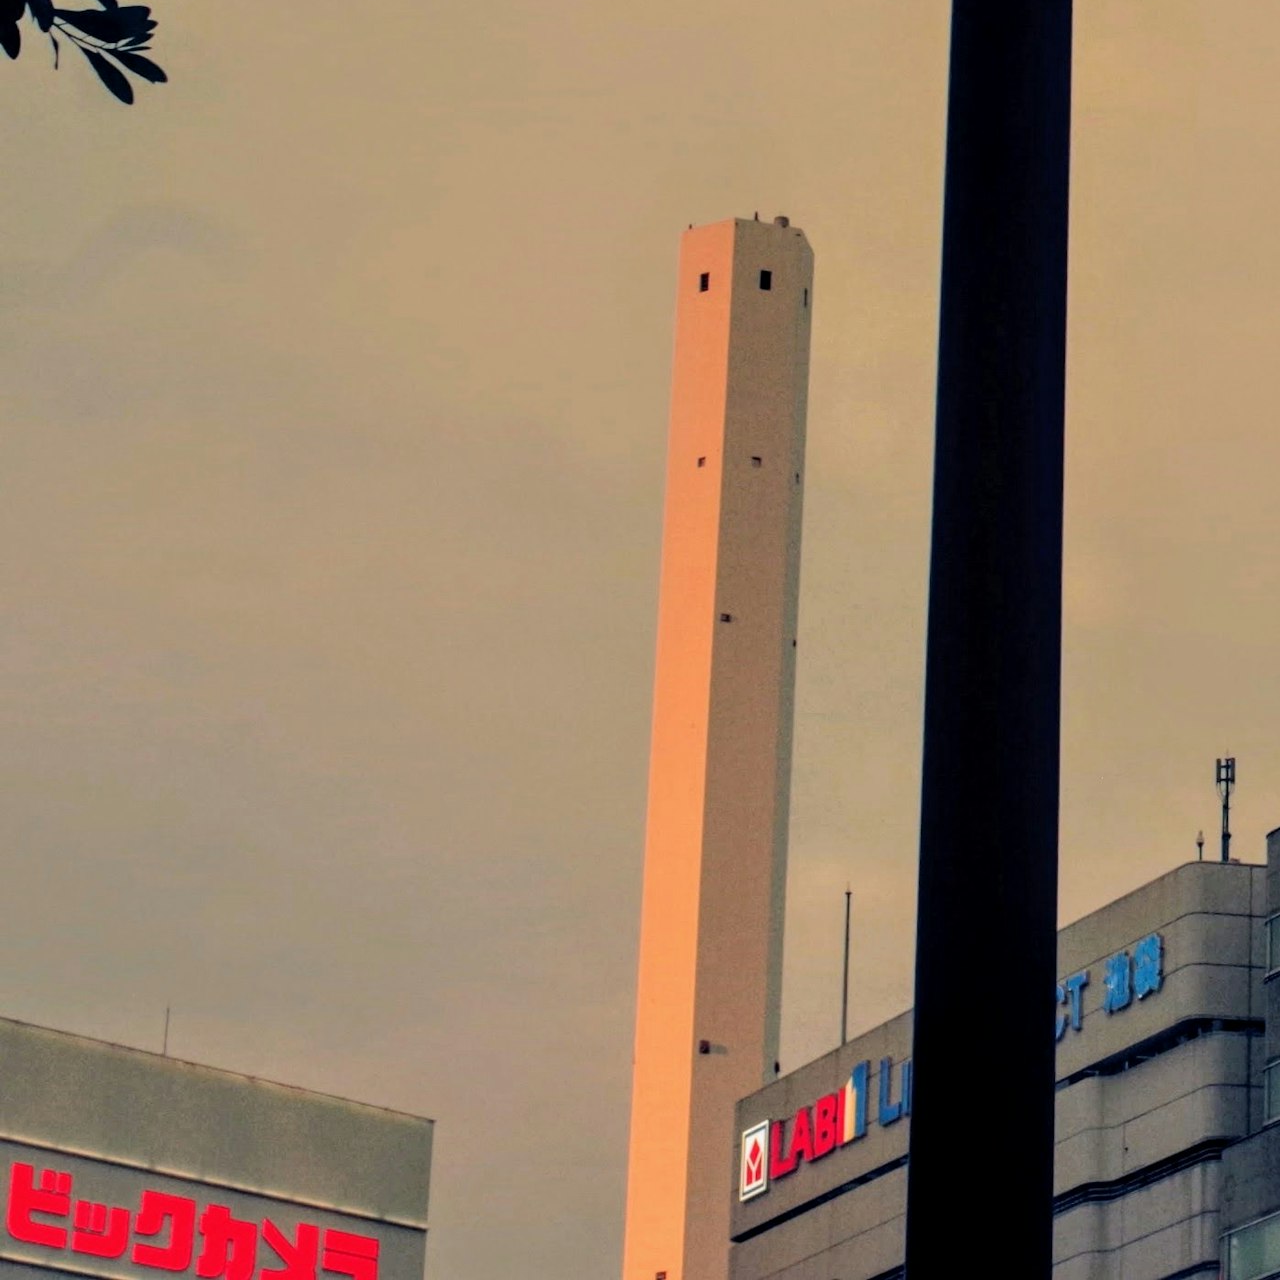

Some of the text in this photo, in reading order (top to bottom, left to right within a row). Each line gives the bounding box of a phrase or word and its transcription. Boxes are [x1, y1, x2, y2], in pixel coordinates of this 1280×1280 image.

[7, 1161, 380, 1280] ビックカメラ
